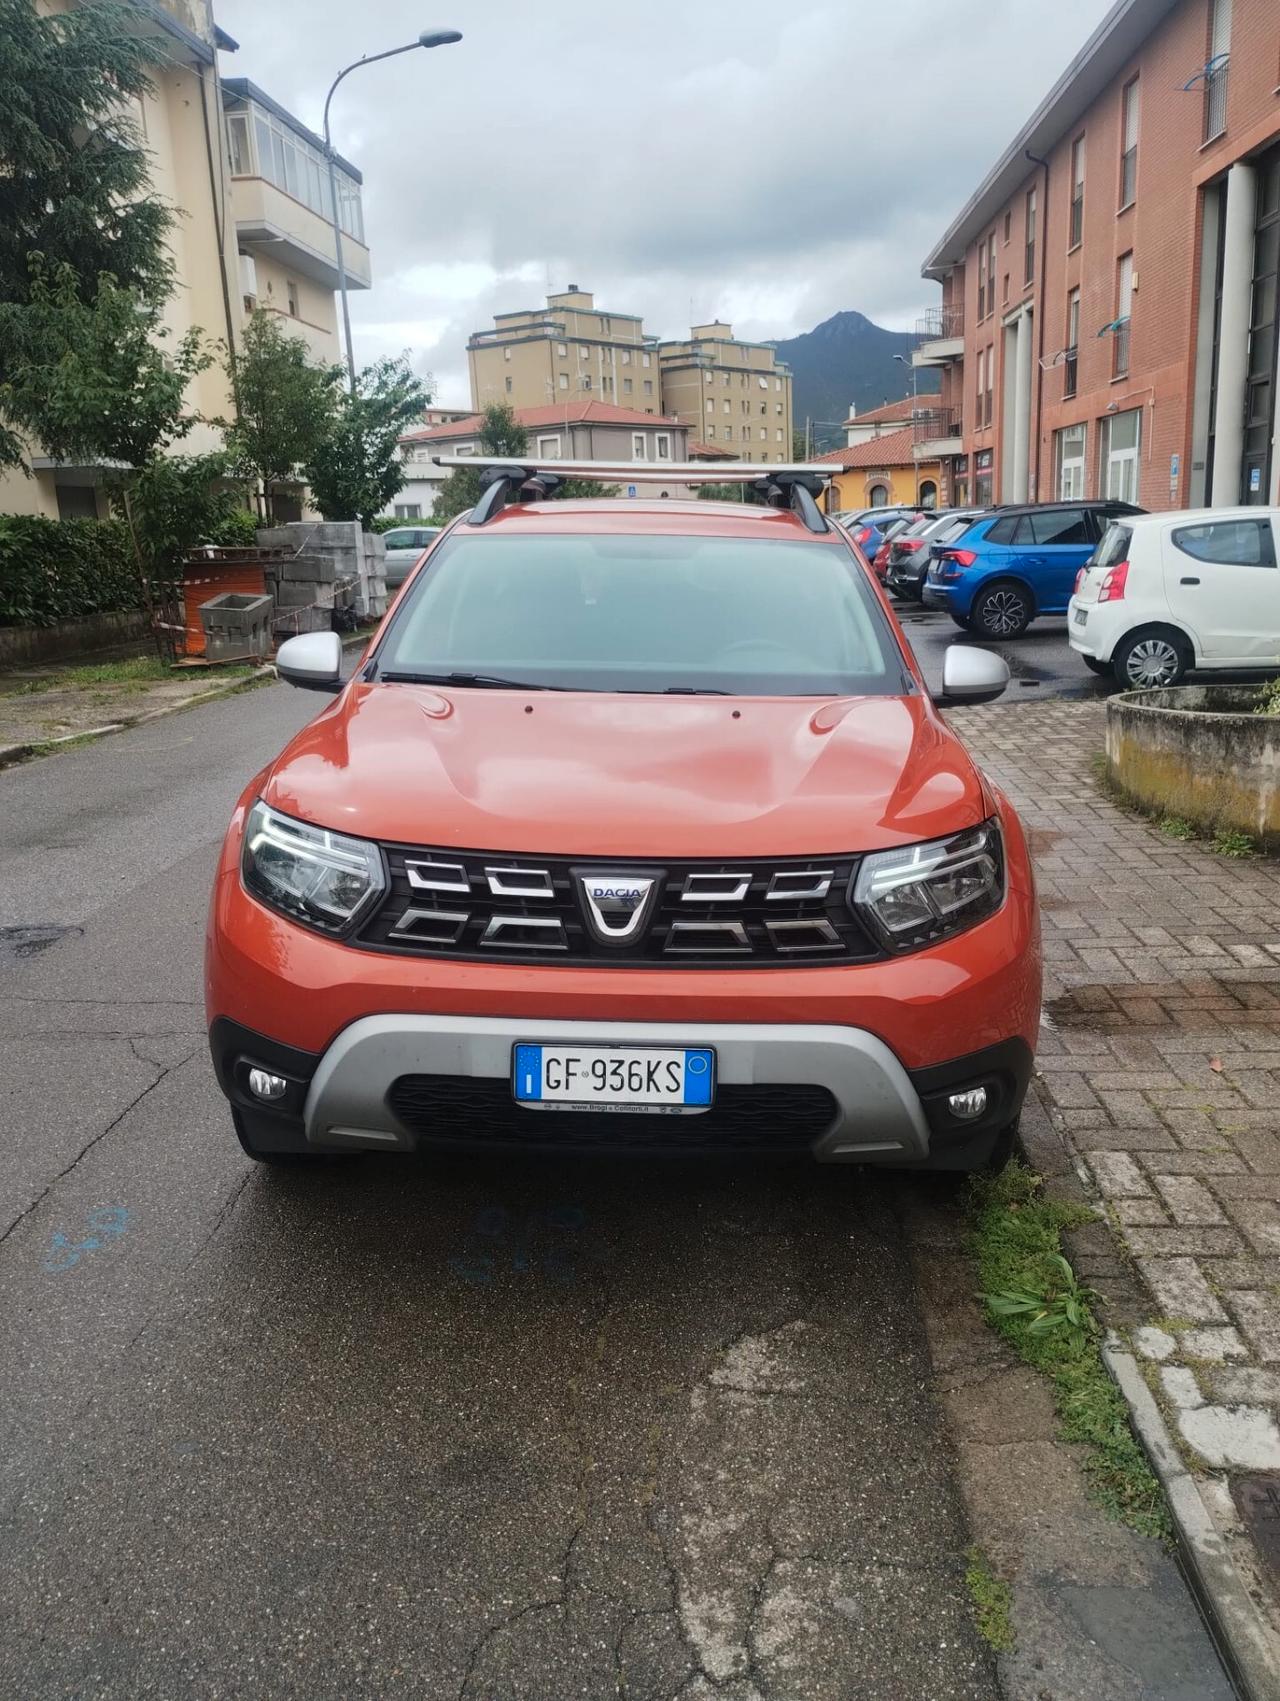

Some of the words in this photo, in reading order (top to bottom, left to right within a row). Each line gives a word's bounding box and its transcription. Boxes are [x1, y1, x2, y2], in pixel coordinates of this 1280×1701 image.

[594, 888, 641, 897] DACIA
[546, 1058, 581, 1090] GF
[591, 1059, 681, 1093] 936KS
